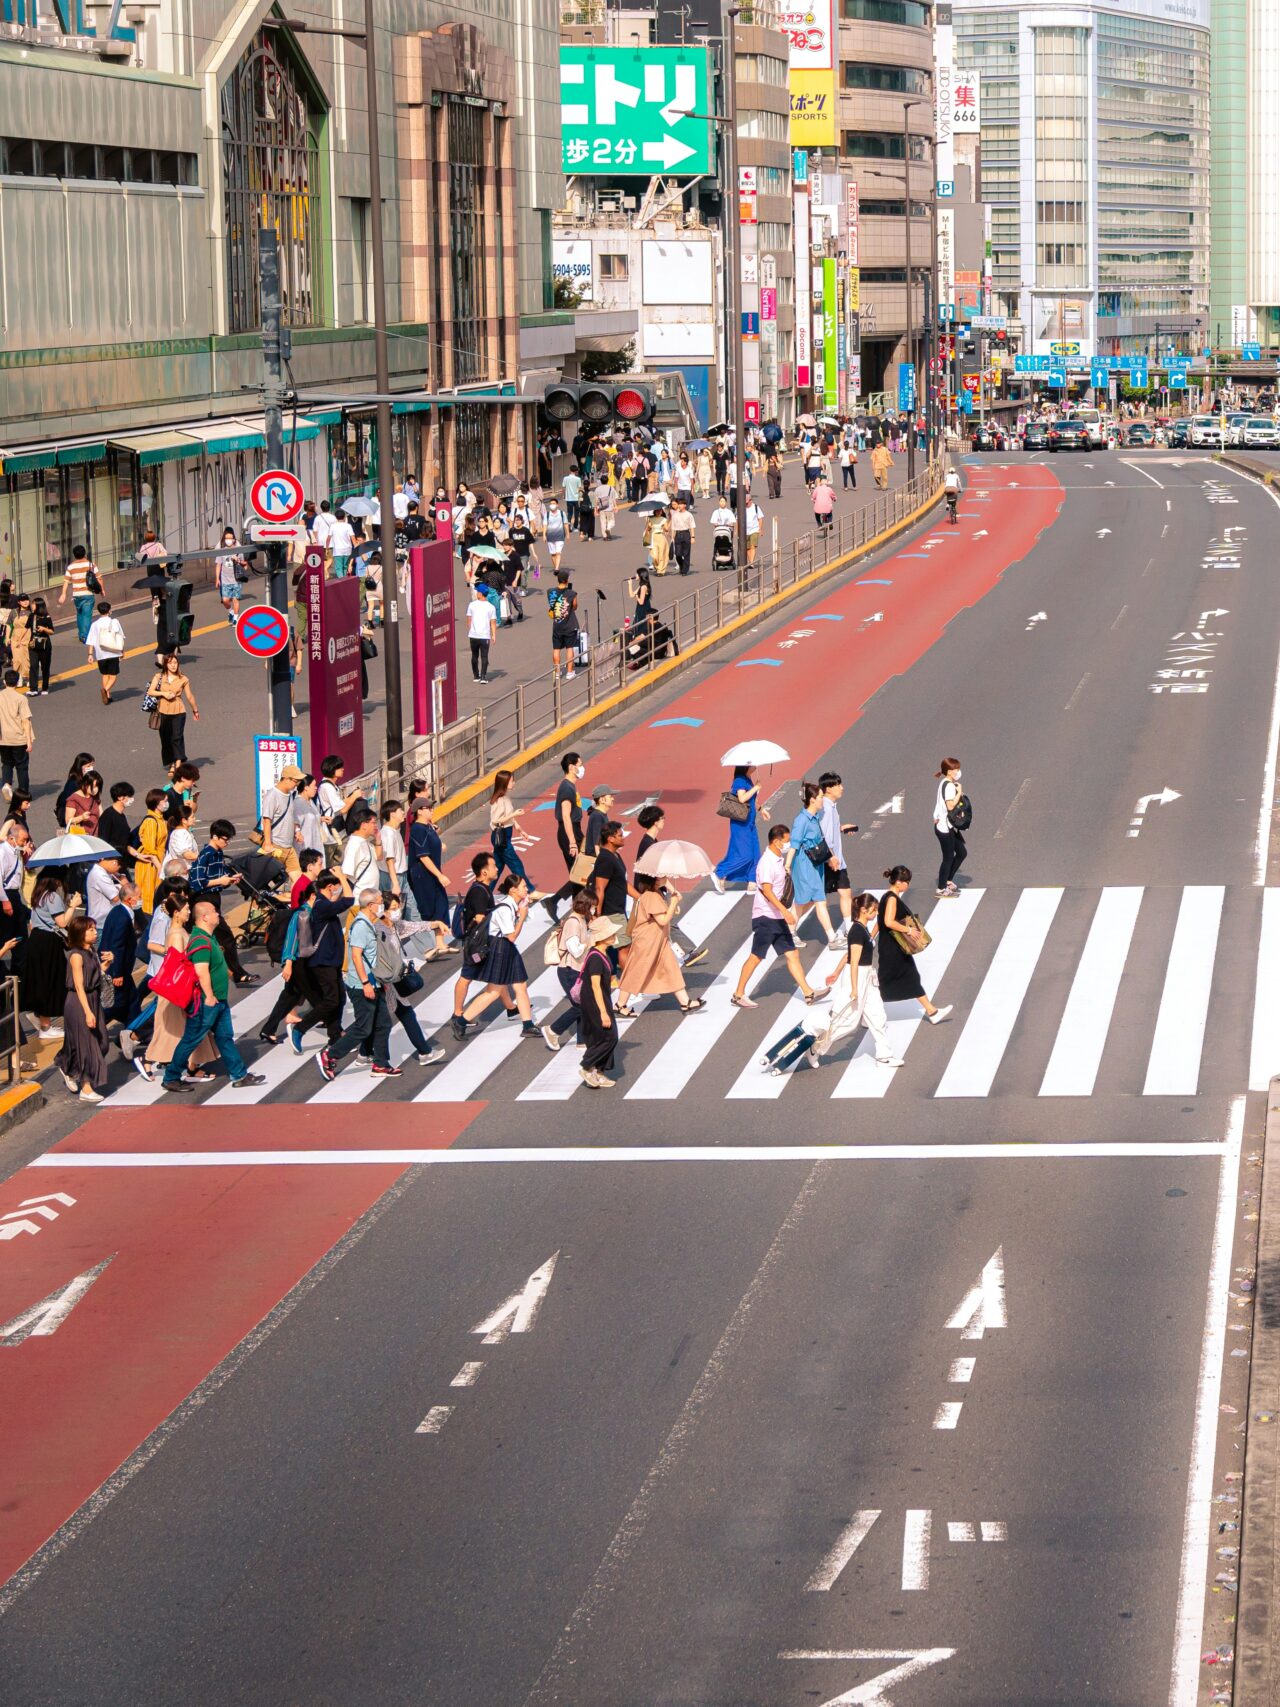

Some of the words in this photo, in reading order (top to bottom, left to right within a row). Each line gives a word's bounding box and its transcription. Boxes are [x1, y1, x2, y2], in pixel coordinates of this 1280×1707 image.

[781, 28, 823, 50] ねこ
[955, 85, 975, 107] 集
[940, 90, 950, 139] OTSUKA
[953, 110, 976, 121] 666
[562, 138, 638, 164] 歩2分
[942, 184, 950, 193] P
[762, 289, 771, 319] Serina
[825, 310, 834, 337] レイク
[799, 327, 807, 361] docomo
[309, 575, 322, 661] 新宿駅南口周辺案内
[259, 741, 297, 751] お知らせ
